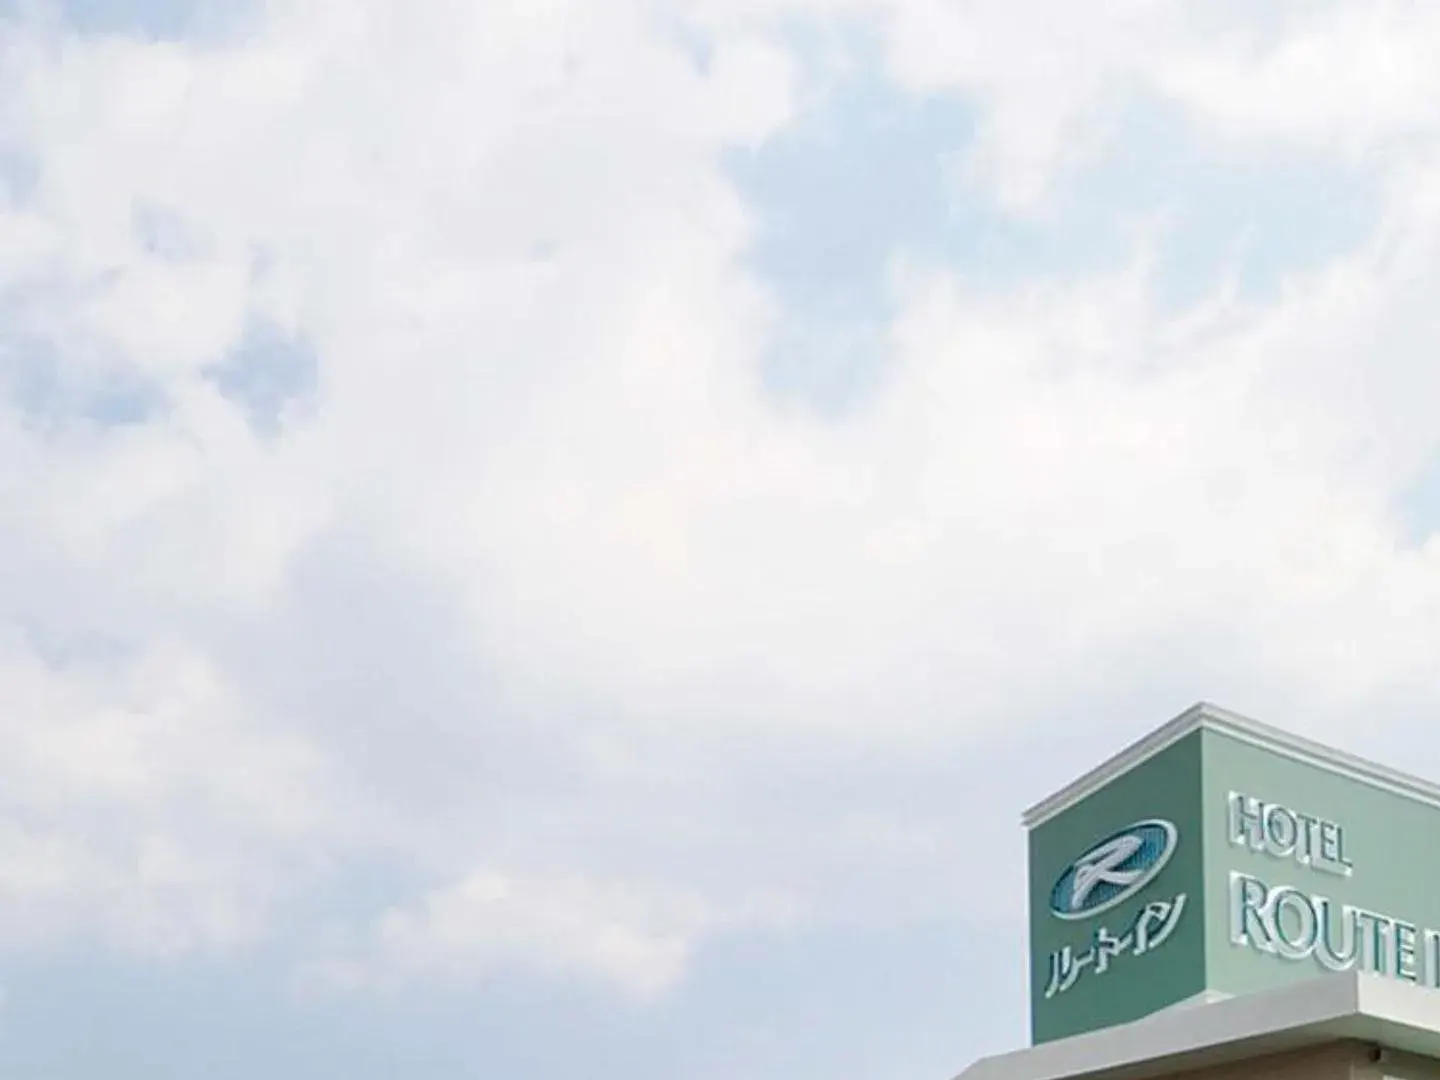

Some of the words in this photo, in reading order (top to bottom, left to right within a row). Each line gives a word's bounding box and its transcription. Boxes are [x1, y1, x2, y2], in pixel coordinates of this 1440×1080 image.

[1228, 790, 1353, 877] HOTEL
[1045, 893, 1188, 998] ルートイン
[1229, 869, 1417, 984] ROUTE
